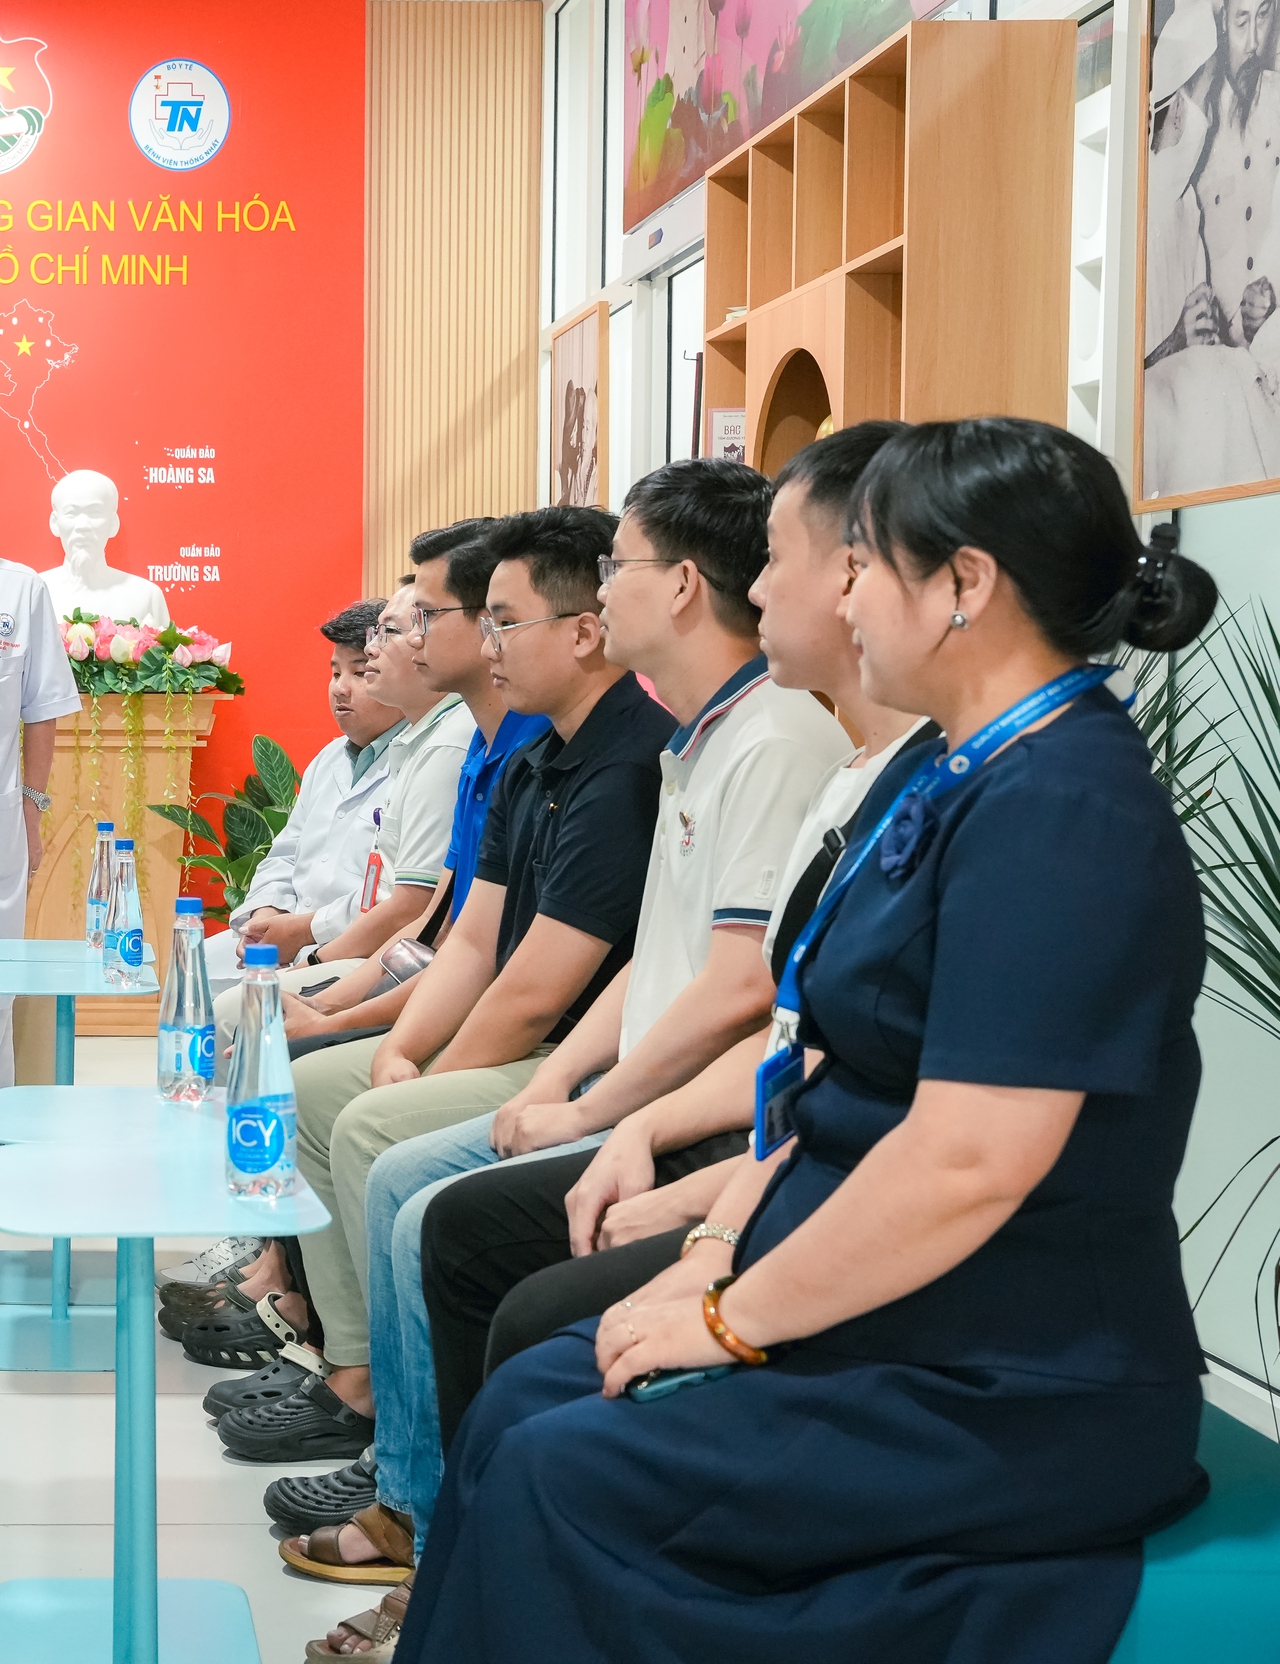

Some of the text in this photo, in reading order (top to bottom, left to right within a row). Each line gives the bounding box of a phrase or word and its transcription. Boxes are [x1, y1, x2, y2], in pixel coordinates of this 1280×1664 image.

[161, 101, 204, 132] TN
[27, 199, 115, 232] GIAN
[128, 194, 202, 232] VĂN
[217, 194, 296, 232] HÓA
[30, 246, 90, 285] CHÍ
[102, 254, 188, 285] MINH
[199, 445, 216, 458] ĐẢO
[149, 464, 215, 483] HOÀNG SA
[204, 544, 220, 557] ĐẢO
[148, 562, 220, 582] TRƯỜNG SA
[126, 936, 142, 952] IC
[198, 1035, 214, 1058] IC
[232, 1118, 277, 1147] ICY
